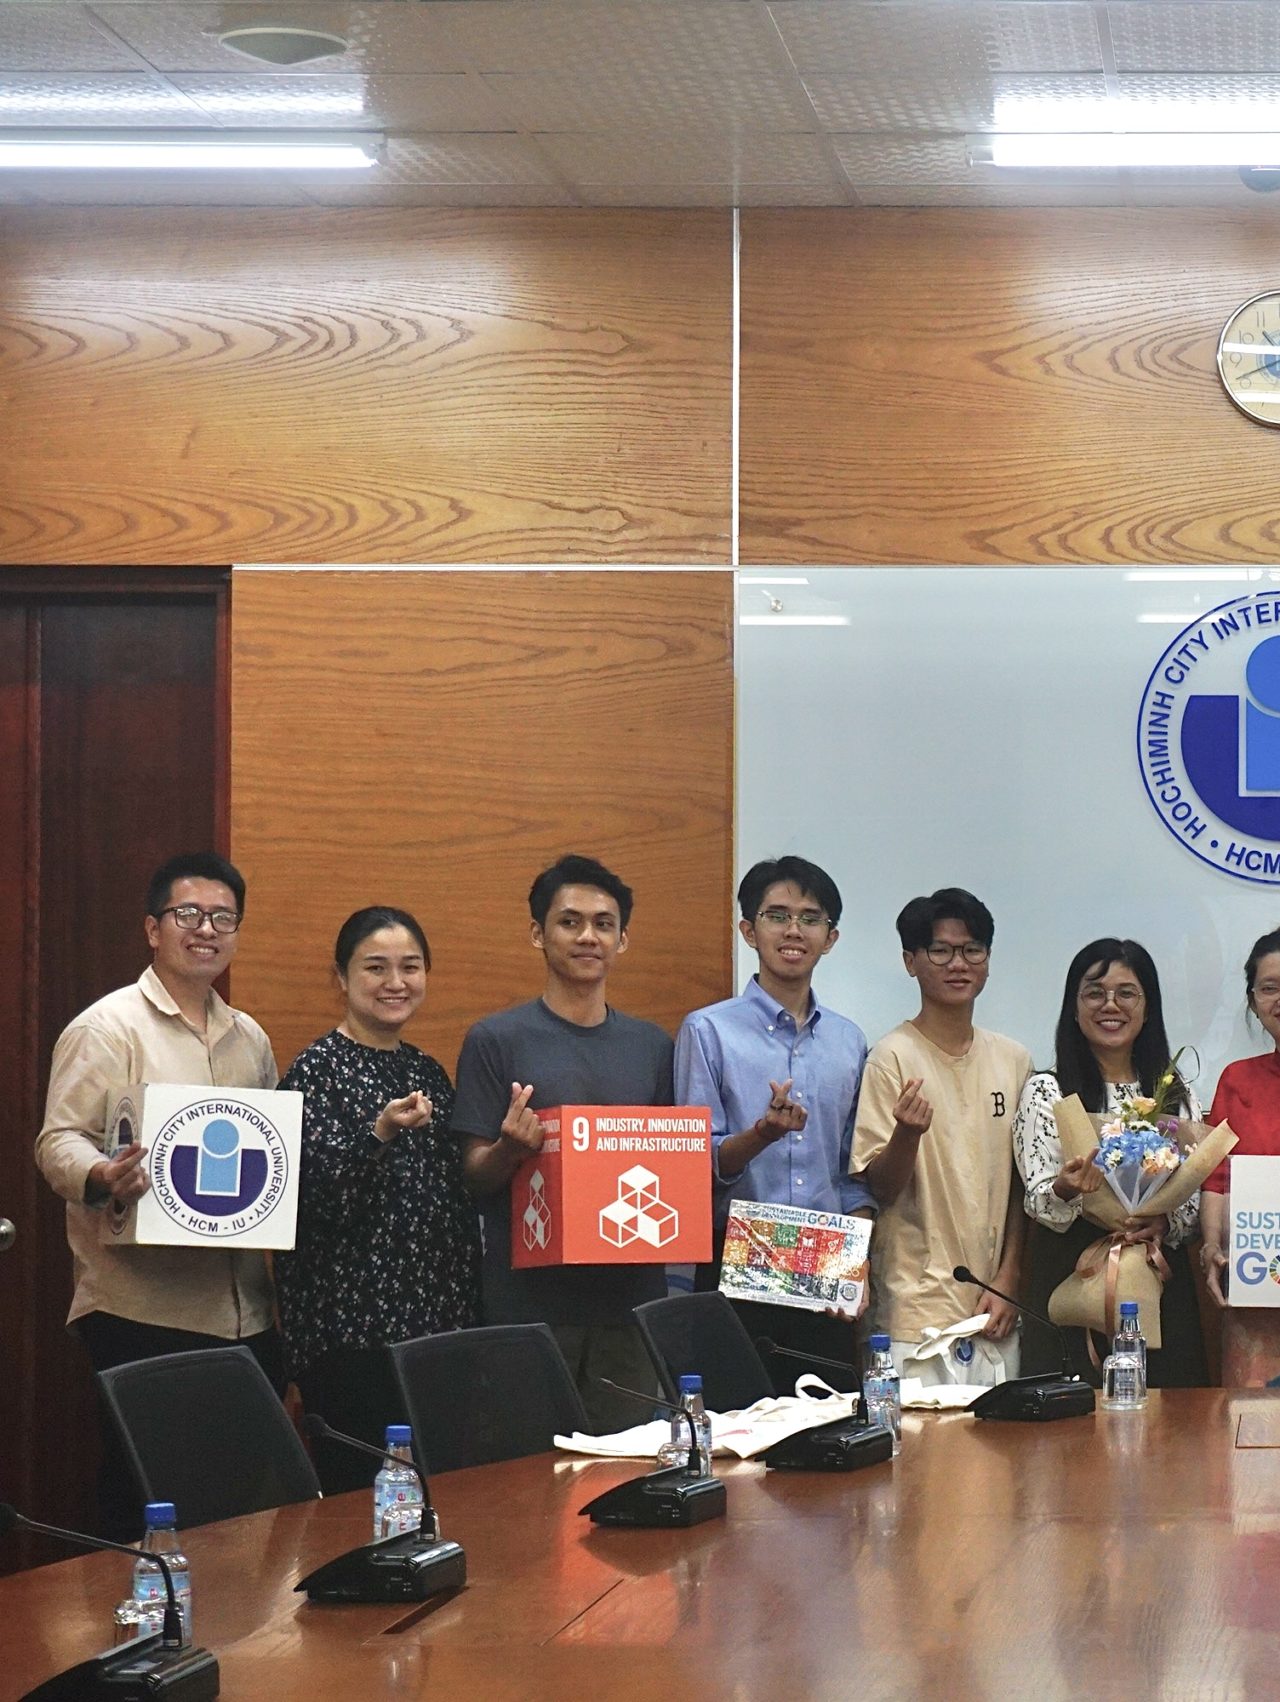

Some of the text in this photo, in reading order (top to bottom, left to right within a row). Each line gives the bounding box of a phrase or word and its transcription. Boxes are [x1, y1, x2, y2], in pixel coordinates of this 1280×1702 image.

[1256, 311, 1266, 328] 11
[1239, 330, 1254, 344] 10
[1230, 352, 1242, 368] 9
[1164, 630, 1210, 684] CITY
[1148, 691, 1207, 840] HOCHIMINH
[991, 1092, 1006, 1117] B
[164, 1115, 186, 1142] CITY
[186, 1104, 277, 1146] INTERNATIONAL
[572, 1116, 590, 1152] 9
[596, 1118, 706, 1134] INDUSTRY, INNOVATION
[596, 1136, 706, 1152] AND INFRASTRUCTURE
[154, 1144, 181, 1214] HOCHIMINH
[254, 1146, 284, 1219] UNIVERSITY
[188, 1215, 218, 1232] HCM
[232, 1218, 246, 1230] IU
[808, 1212, 856, 1230] GOALS
